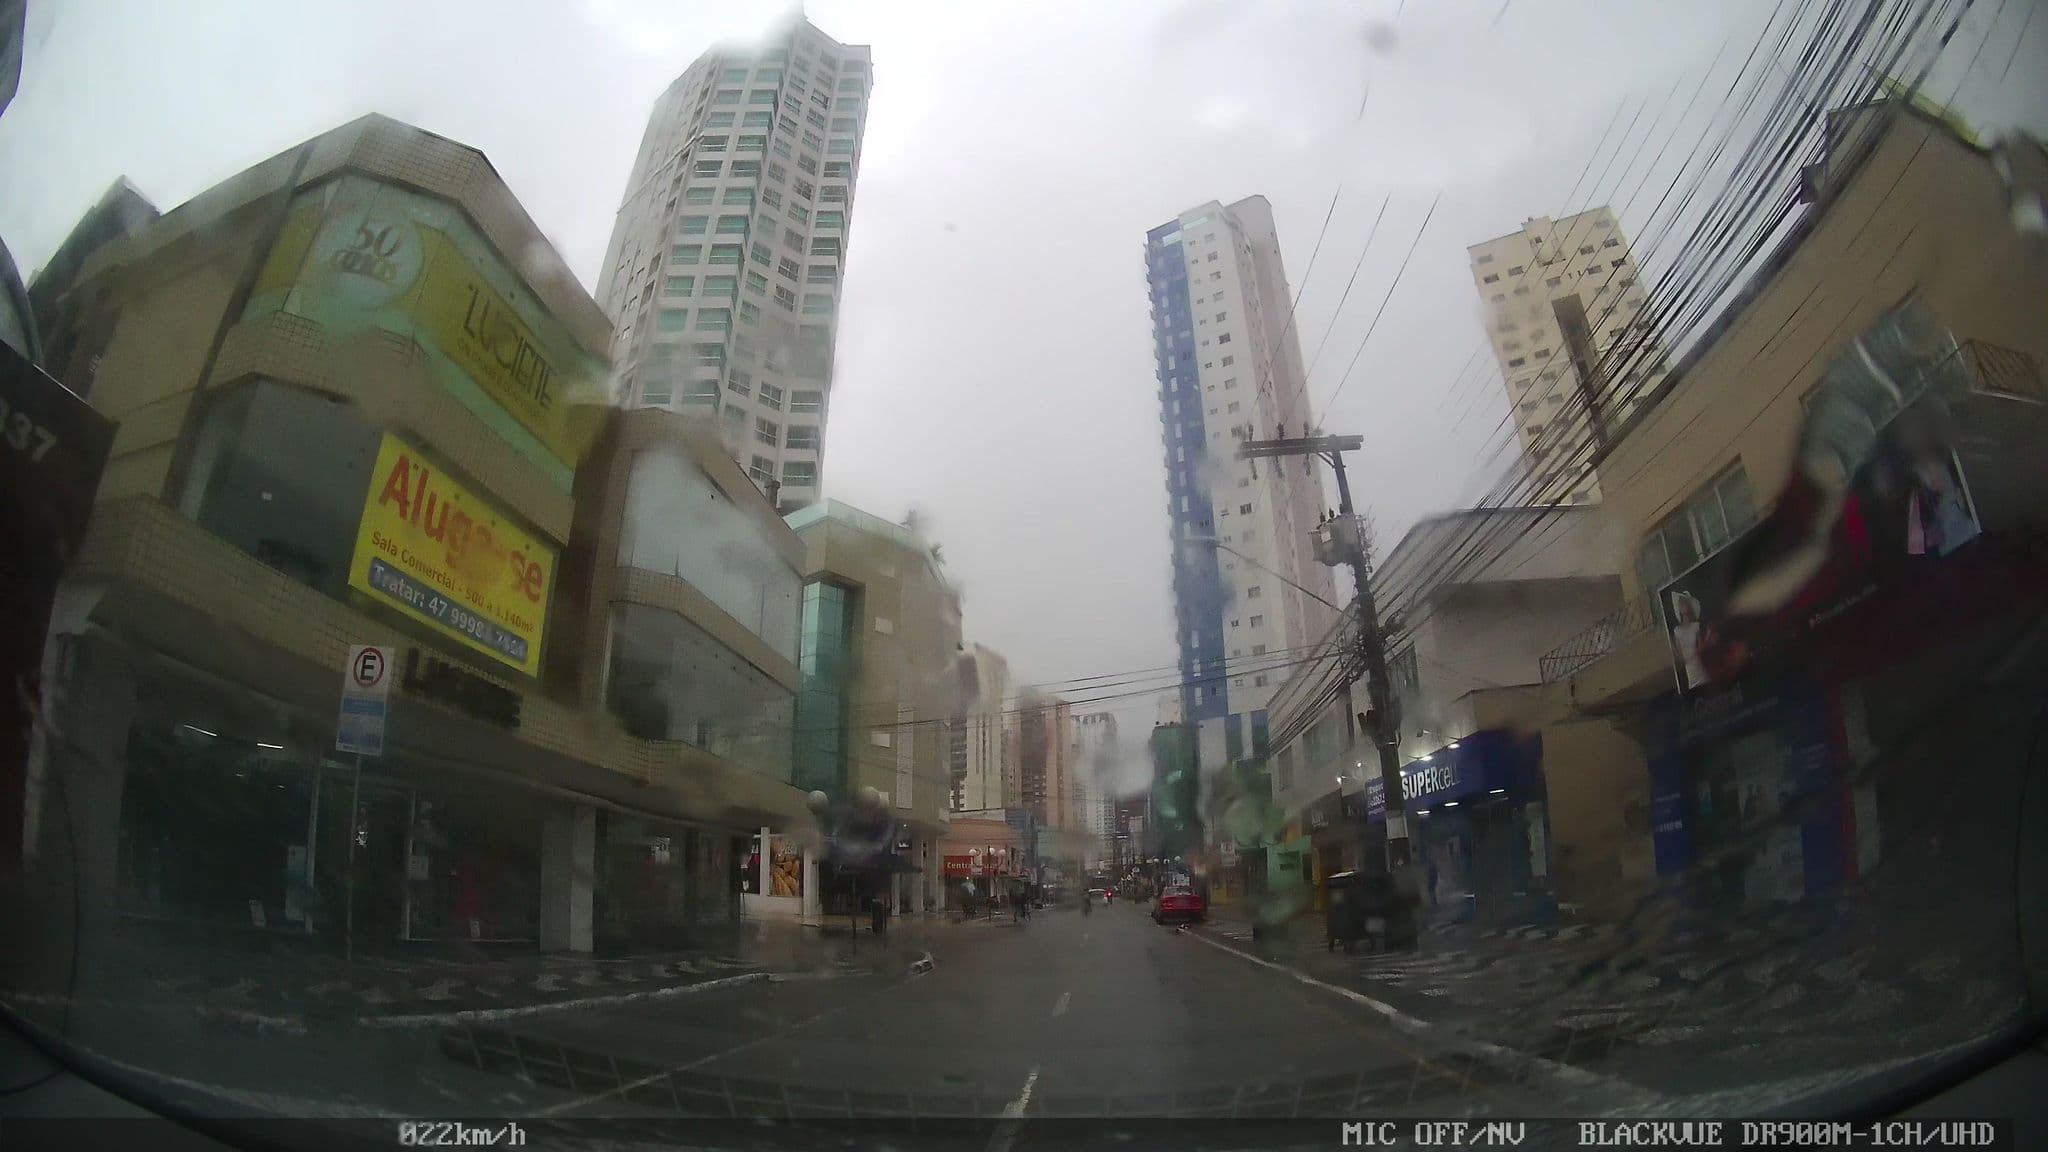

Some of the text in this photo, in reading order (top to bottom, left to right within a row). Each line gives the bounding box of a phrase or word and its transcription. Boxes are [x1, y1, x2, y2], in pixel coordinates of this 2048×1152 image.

[371, 531, 398, 557] Sala
[401, 549, 456, 592] Comercial
[466, 590, 485, 608] 500
[428, 595, 447, 617] 47
[360, 654, 377, 681] E
